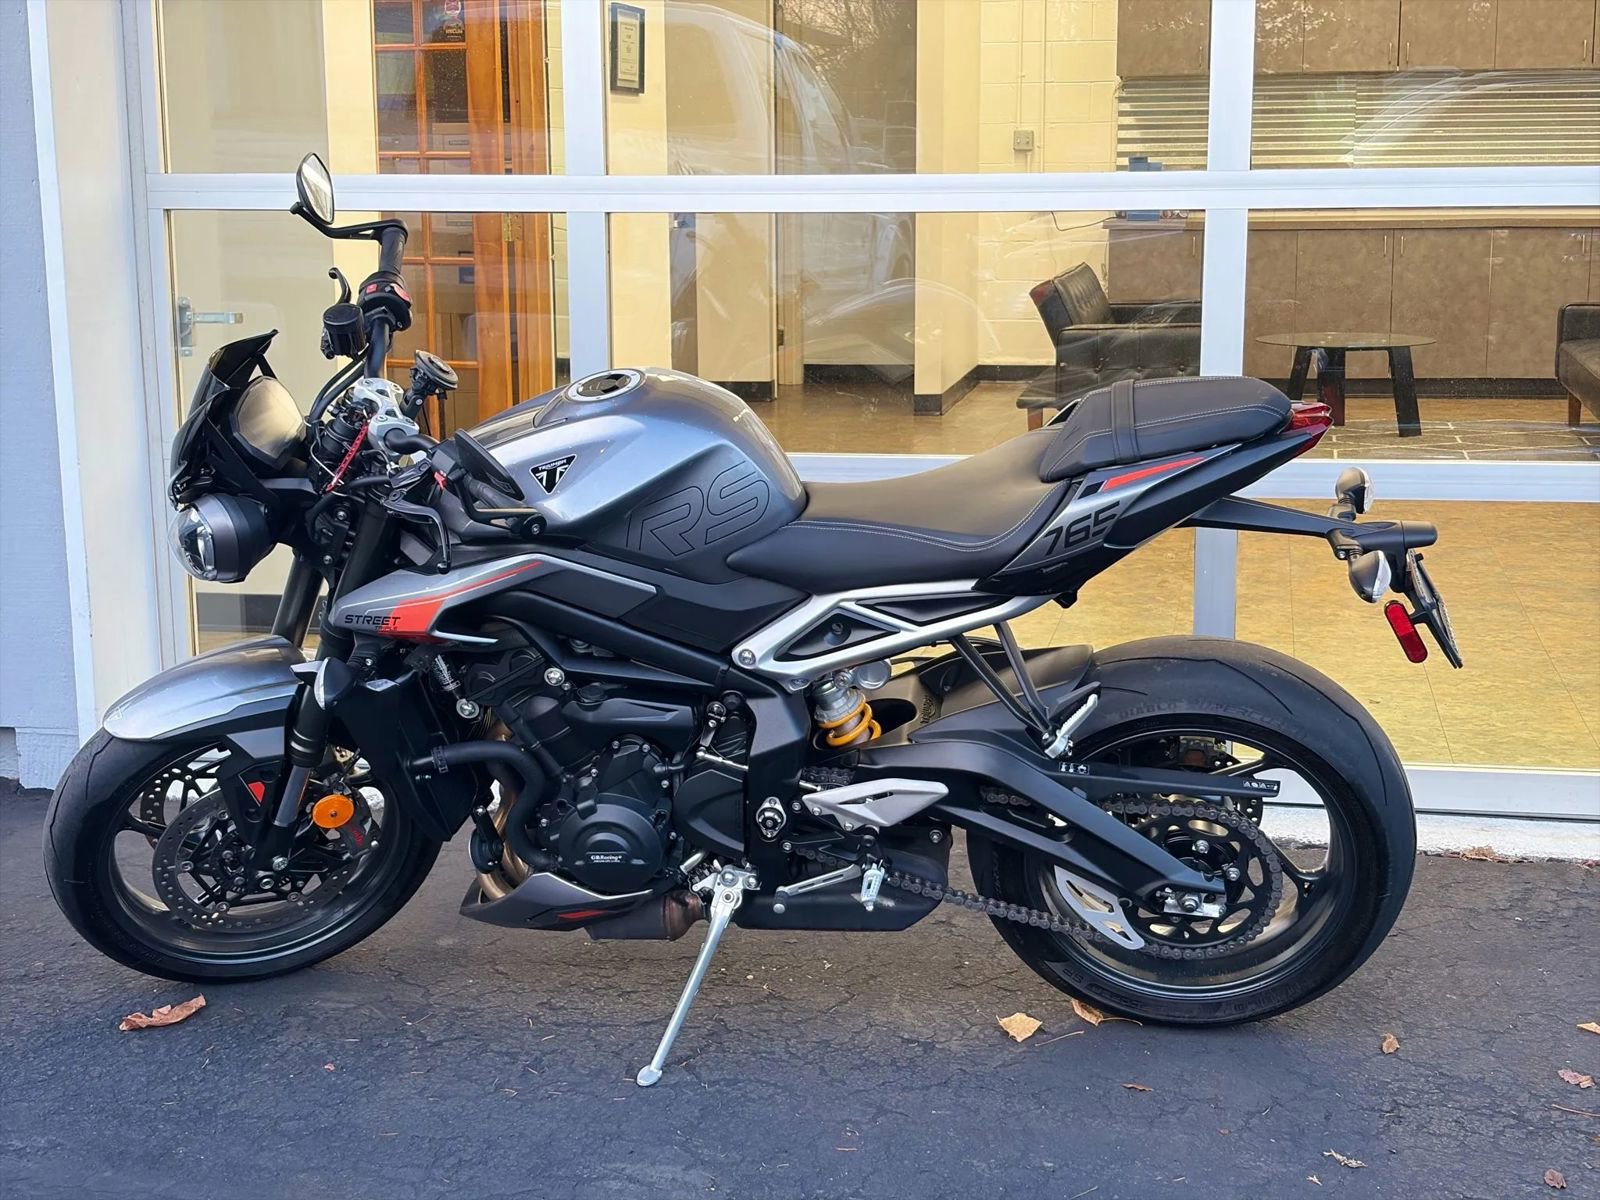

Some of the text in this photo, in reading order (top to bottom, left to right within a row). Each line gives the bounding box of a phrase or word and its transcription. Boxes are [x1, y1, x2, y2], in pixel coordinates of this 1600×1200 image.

[626, 460, 770, 557] RS
[1043, 500, 1121, 556] 765
[344, 614, 401, 626] STREET
